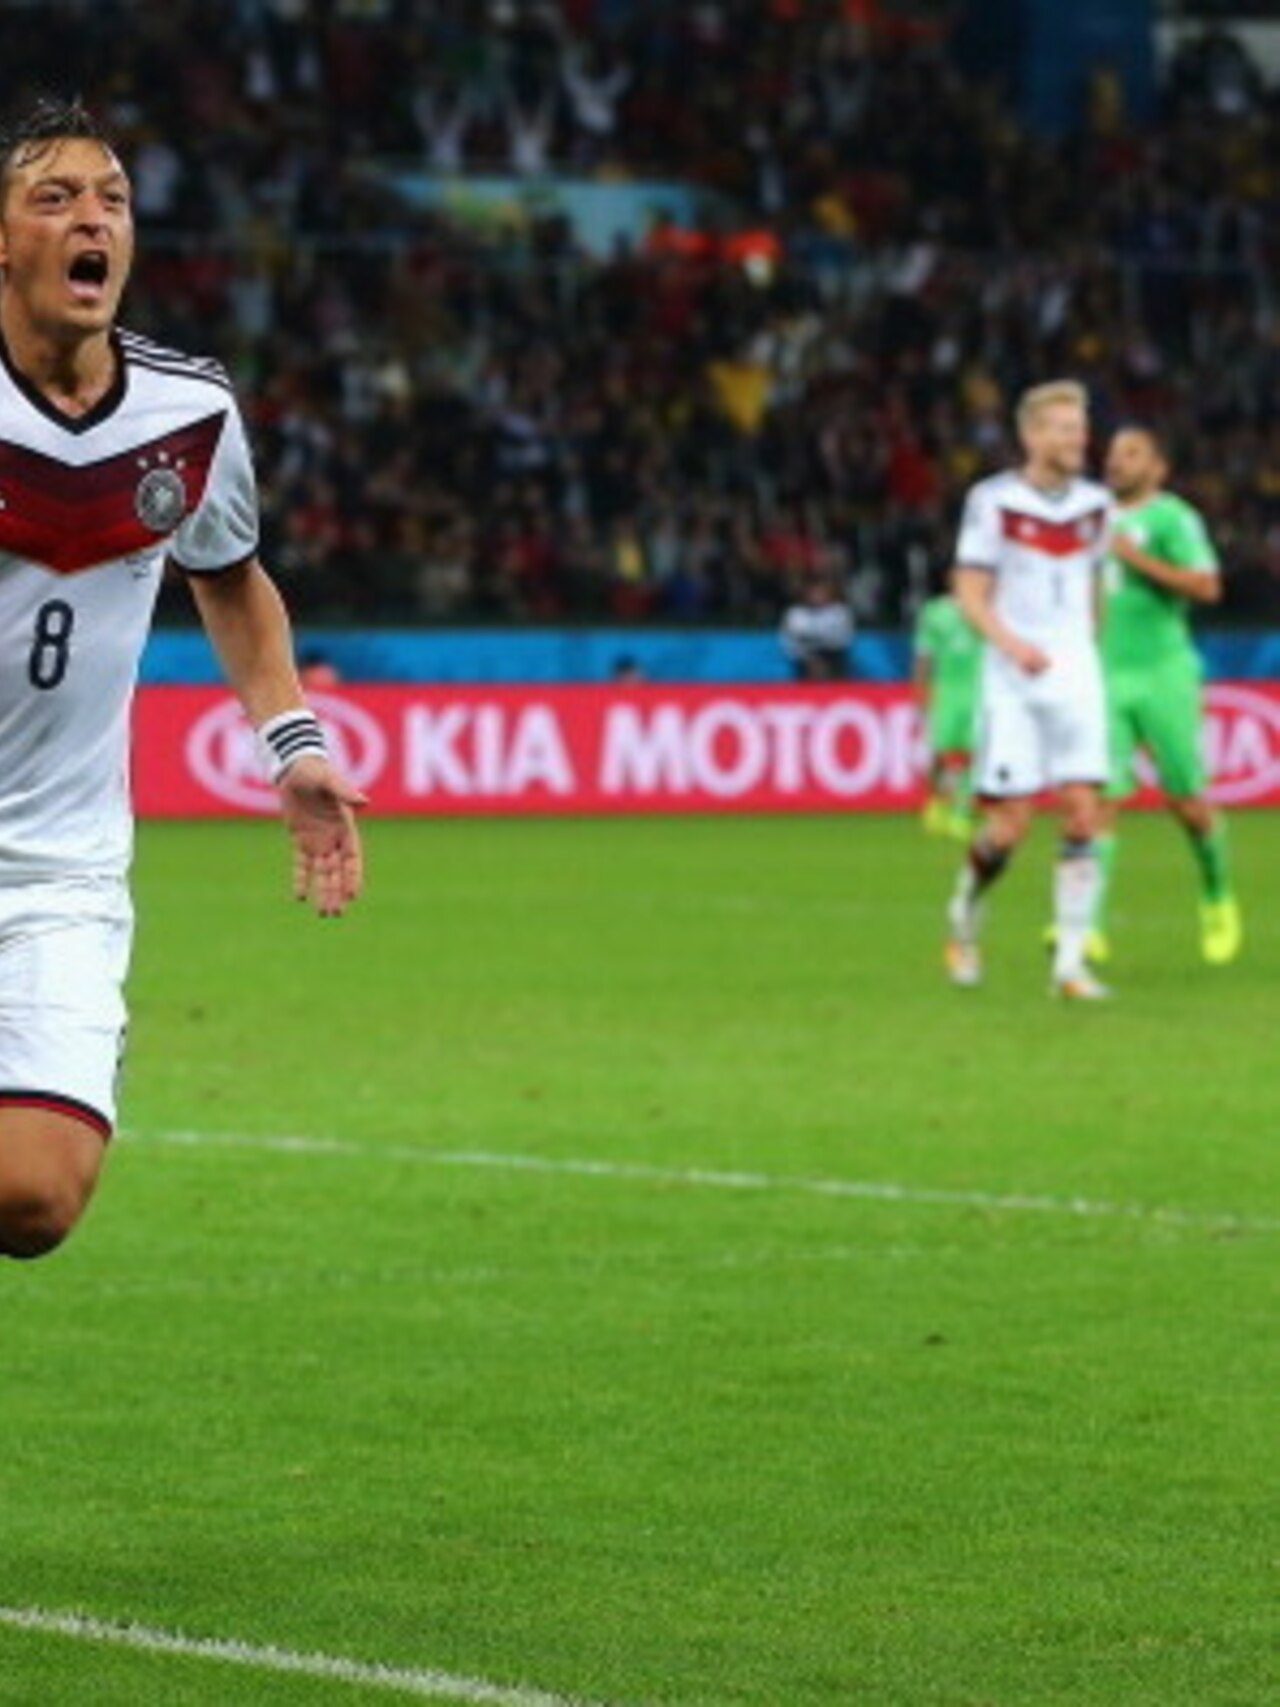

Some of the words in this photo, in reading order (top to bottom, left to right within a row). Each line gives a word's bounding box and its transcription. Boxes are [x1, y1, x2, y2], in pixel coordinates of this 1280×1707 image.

[29, 598, 74, 690] 8
[403, 703, 577, 797] KIA
[1197, 717, 1269, 777] IA
